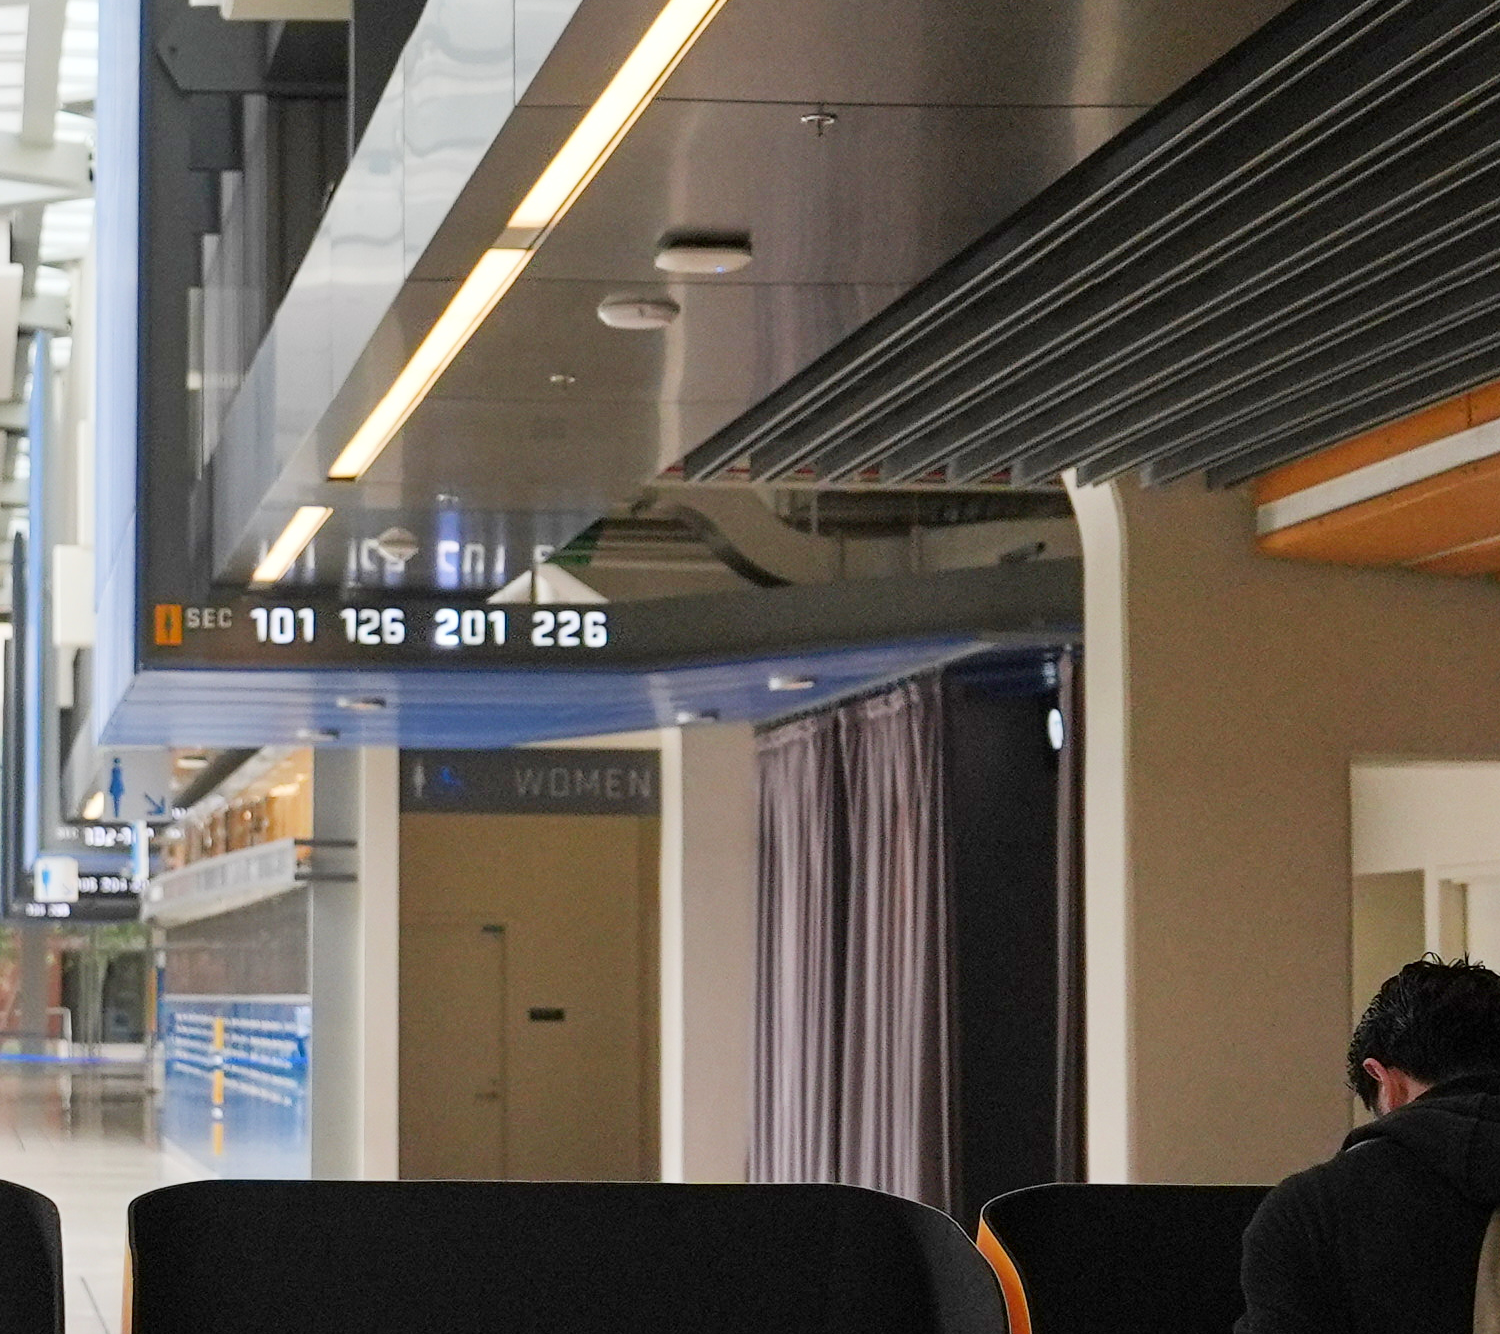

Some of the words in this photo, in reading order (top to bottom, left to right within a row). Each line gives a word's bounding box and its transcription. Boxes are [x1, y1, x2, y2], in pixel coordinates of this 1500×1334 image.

[185, 606, 234, 630] SEC
[249, 606, 315, 646] 101
[340, 607, 406, 646] 126
[433, 607, 508, 648] 201
[530, 608, 609, 649] 226
[515, 768, 651, 798] WOMEN
